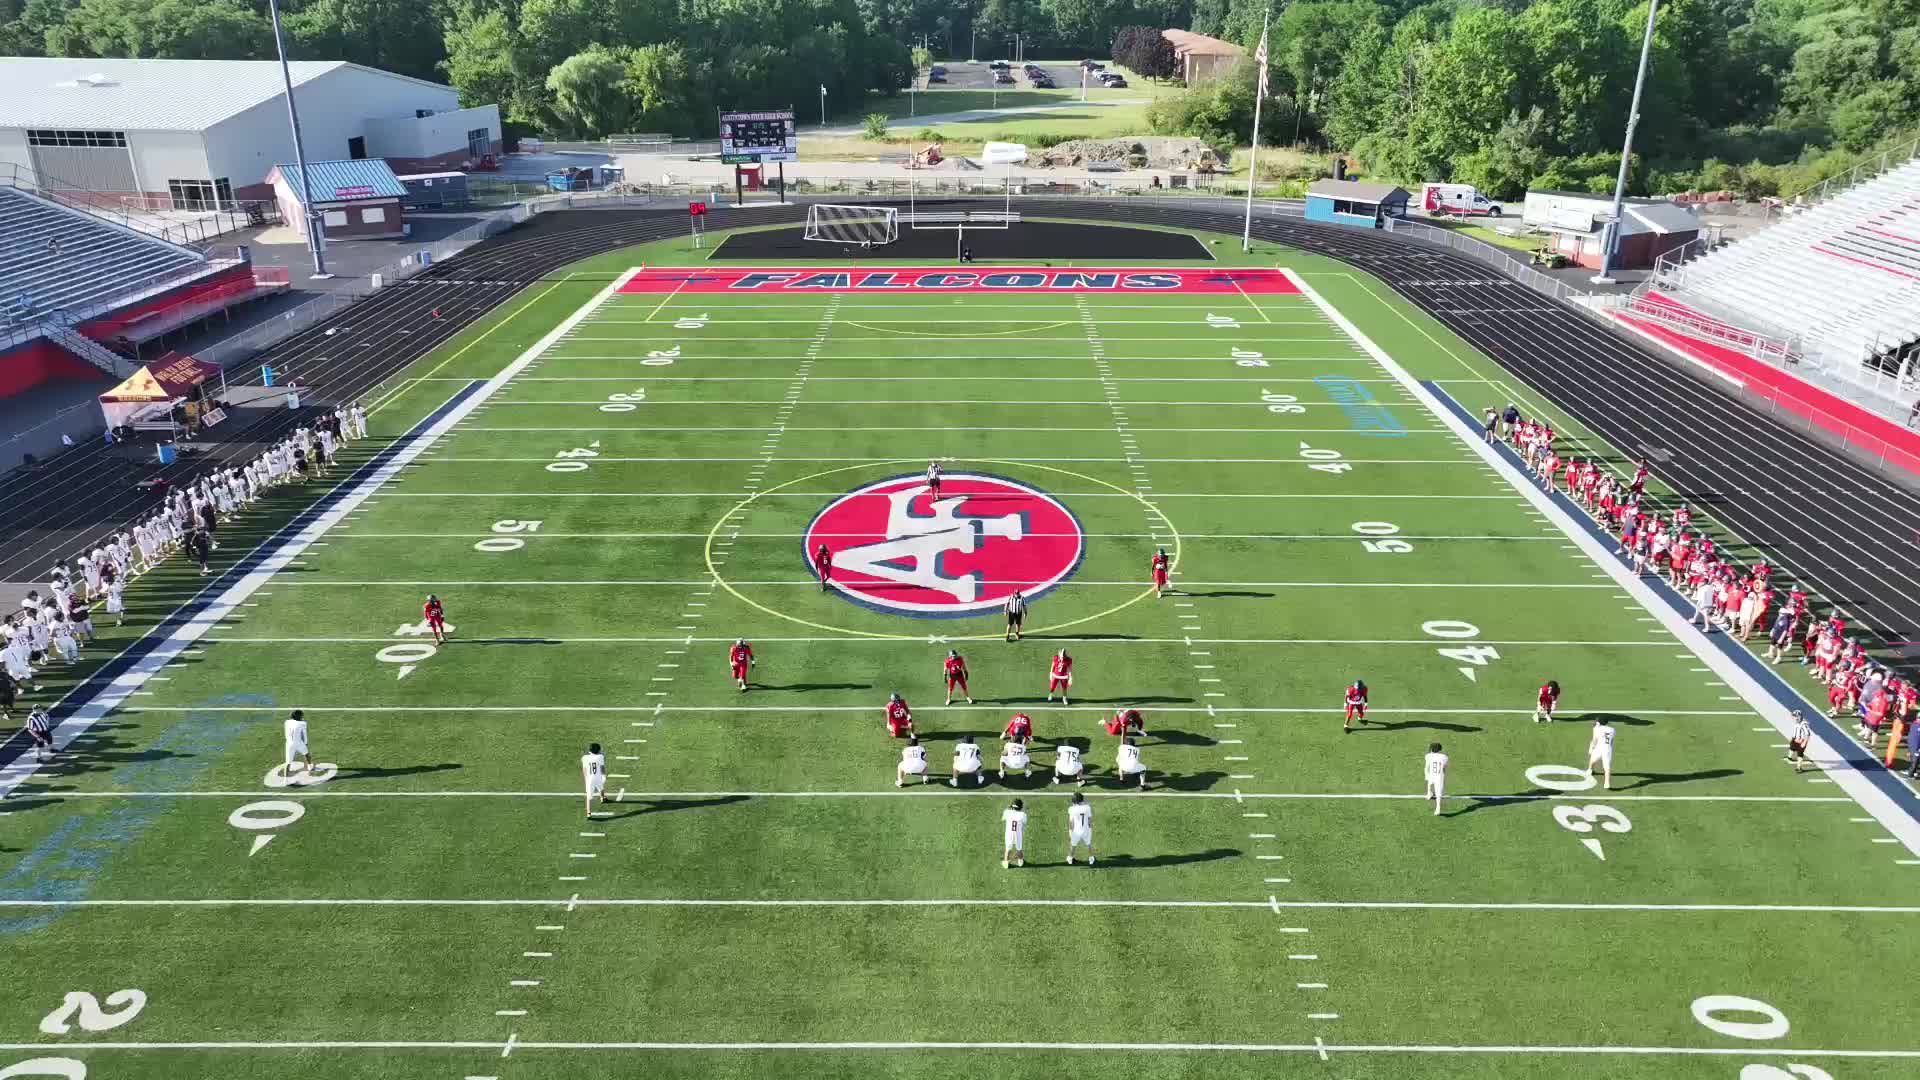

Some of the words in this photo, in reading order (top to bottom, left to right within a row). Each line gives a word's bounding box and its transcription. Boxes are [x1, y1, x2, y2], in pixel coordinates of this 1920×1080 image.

[729, 273, 1182, 289] FALCONS
[640, 350, 681, 366] 20
[598, 393, 646, 412] 30
[1261, 394, 1306, 413] 30
[545, 448, 600, 472] 40
[1300, 449, 1352, 474] 40
[474, 519, 544, 551] 50
[1352, 521, 1414, 553] 50
[1422, 620, 1500, 665] 40
[228, 761, 338, 829] 30
[1525, 765, 1632, 833] 30
